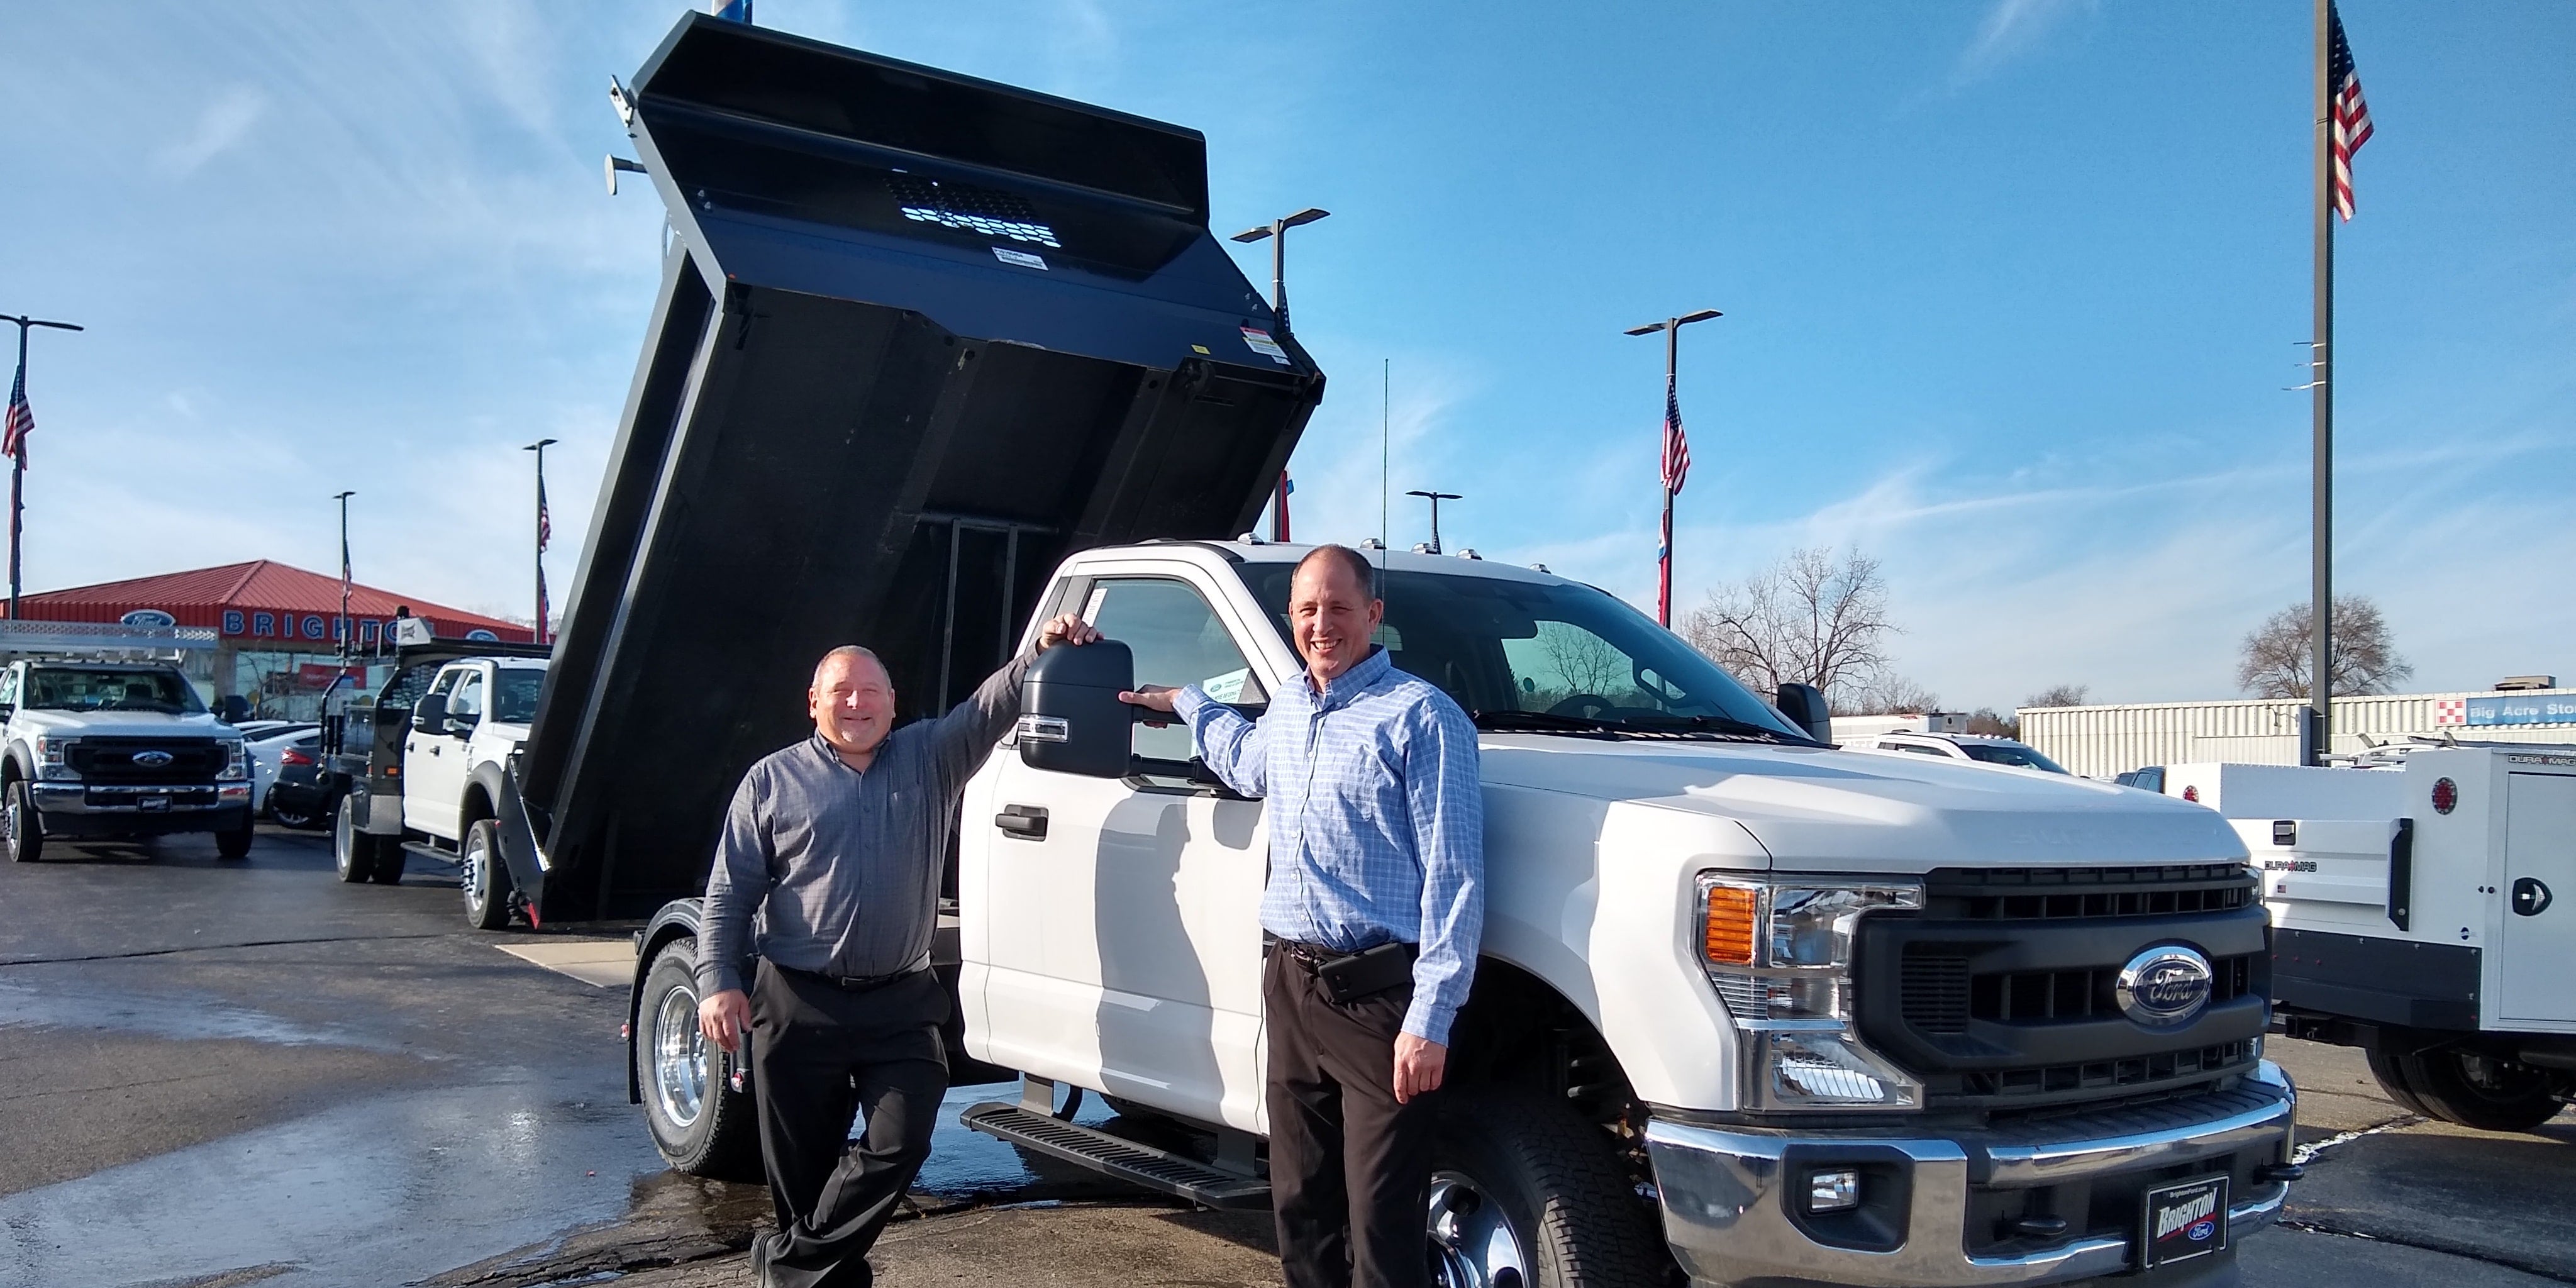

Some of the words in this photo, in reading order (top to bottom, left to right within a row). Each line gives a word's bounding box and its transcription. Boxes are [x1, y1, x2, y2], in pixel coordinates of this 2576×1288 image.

[223, 610, 434, 643] BRIGHTO
[2470, 707, 2495, 719] Big
[2502, 706, 2539, 716] Acre
[2547, 704, 2576, 714] Sto
[2150, 968, 2194, 1004] Ford
[2193, 1224, 2209, 1238] Ford
